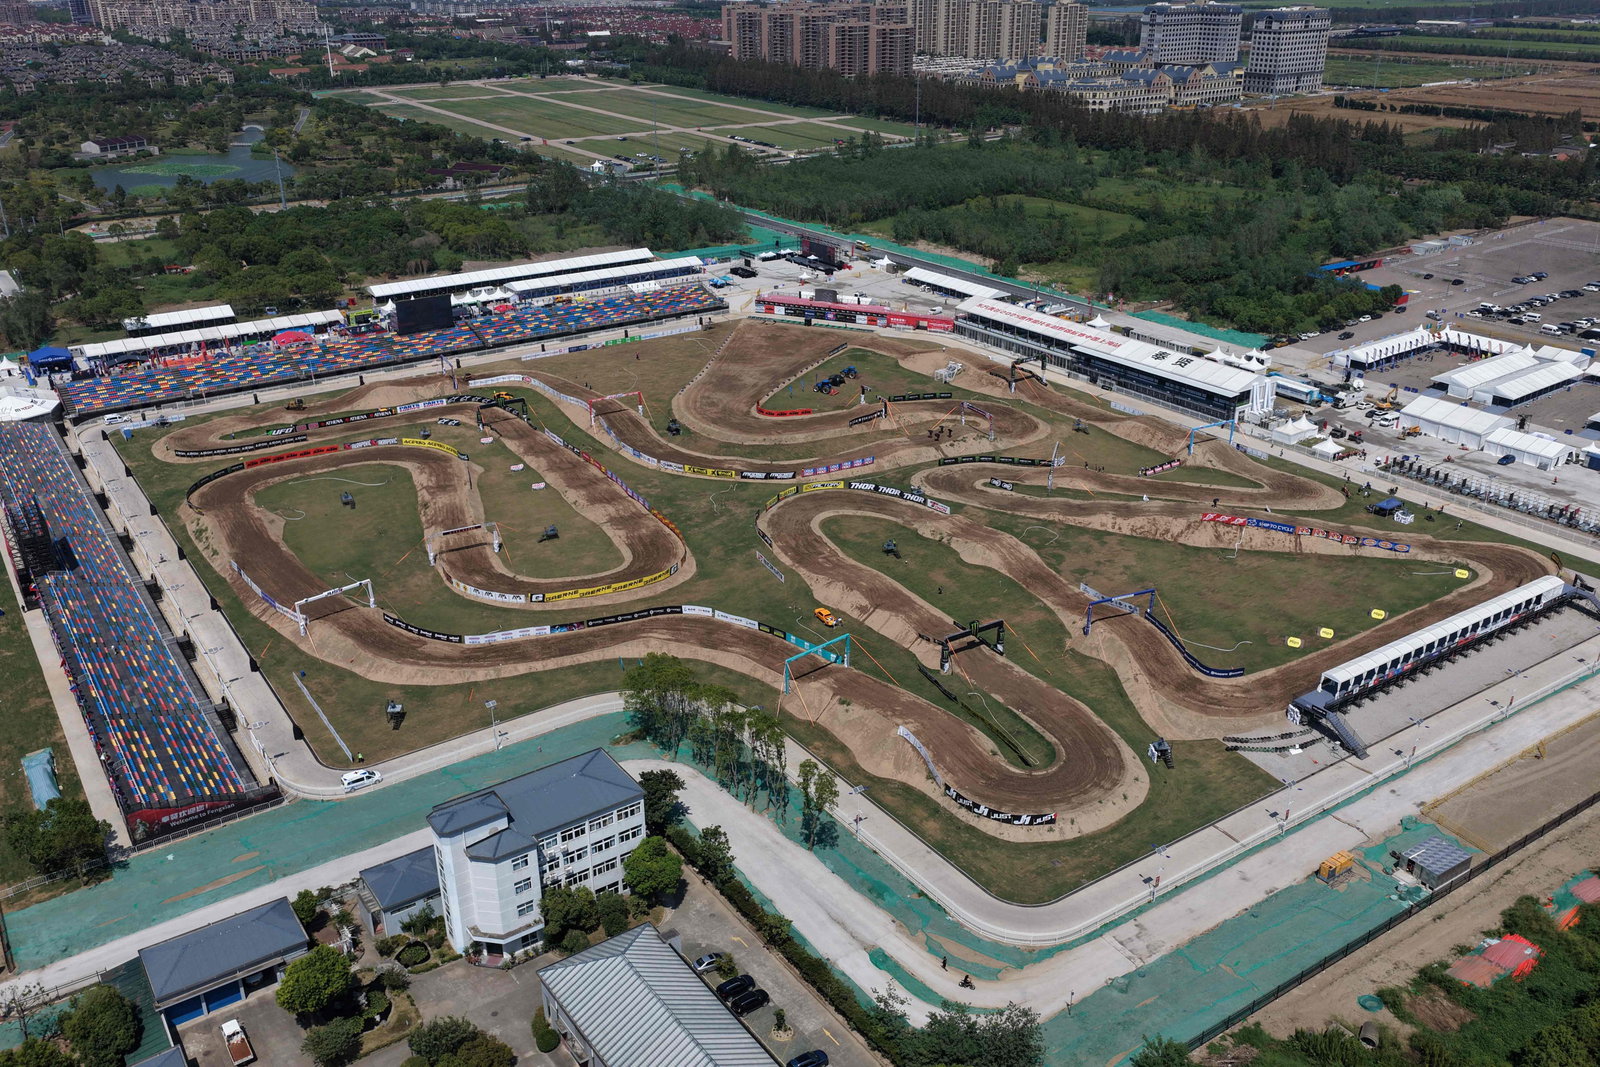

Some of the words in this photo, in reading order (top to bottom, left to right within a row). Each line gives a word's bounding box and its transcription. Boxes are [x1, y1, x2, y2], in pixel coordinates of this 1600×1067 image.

[878, 486, 901, 496] THOR
[903, 492, 925, 504] THOR
[170, 814, 199, 827] Welcome
[207, 803, 235, 816] Fengxian
[957, 798, 973, 806] JUST
[1033, 813, 1055, 824] JUST
